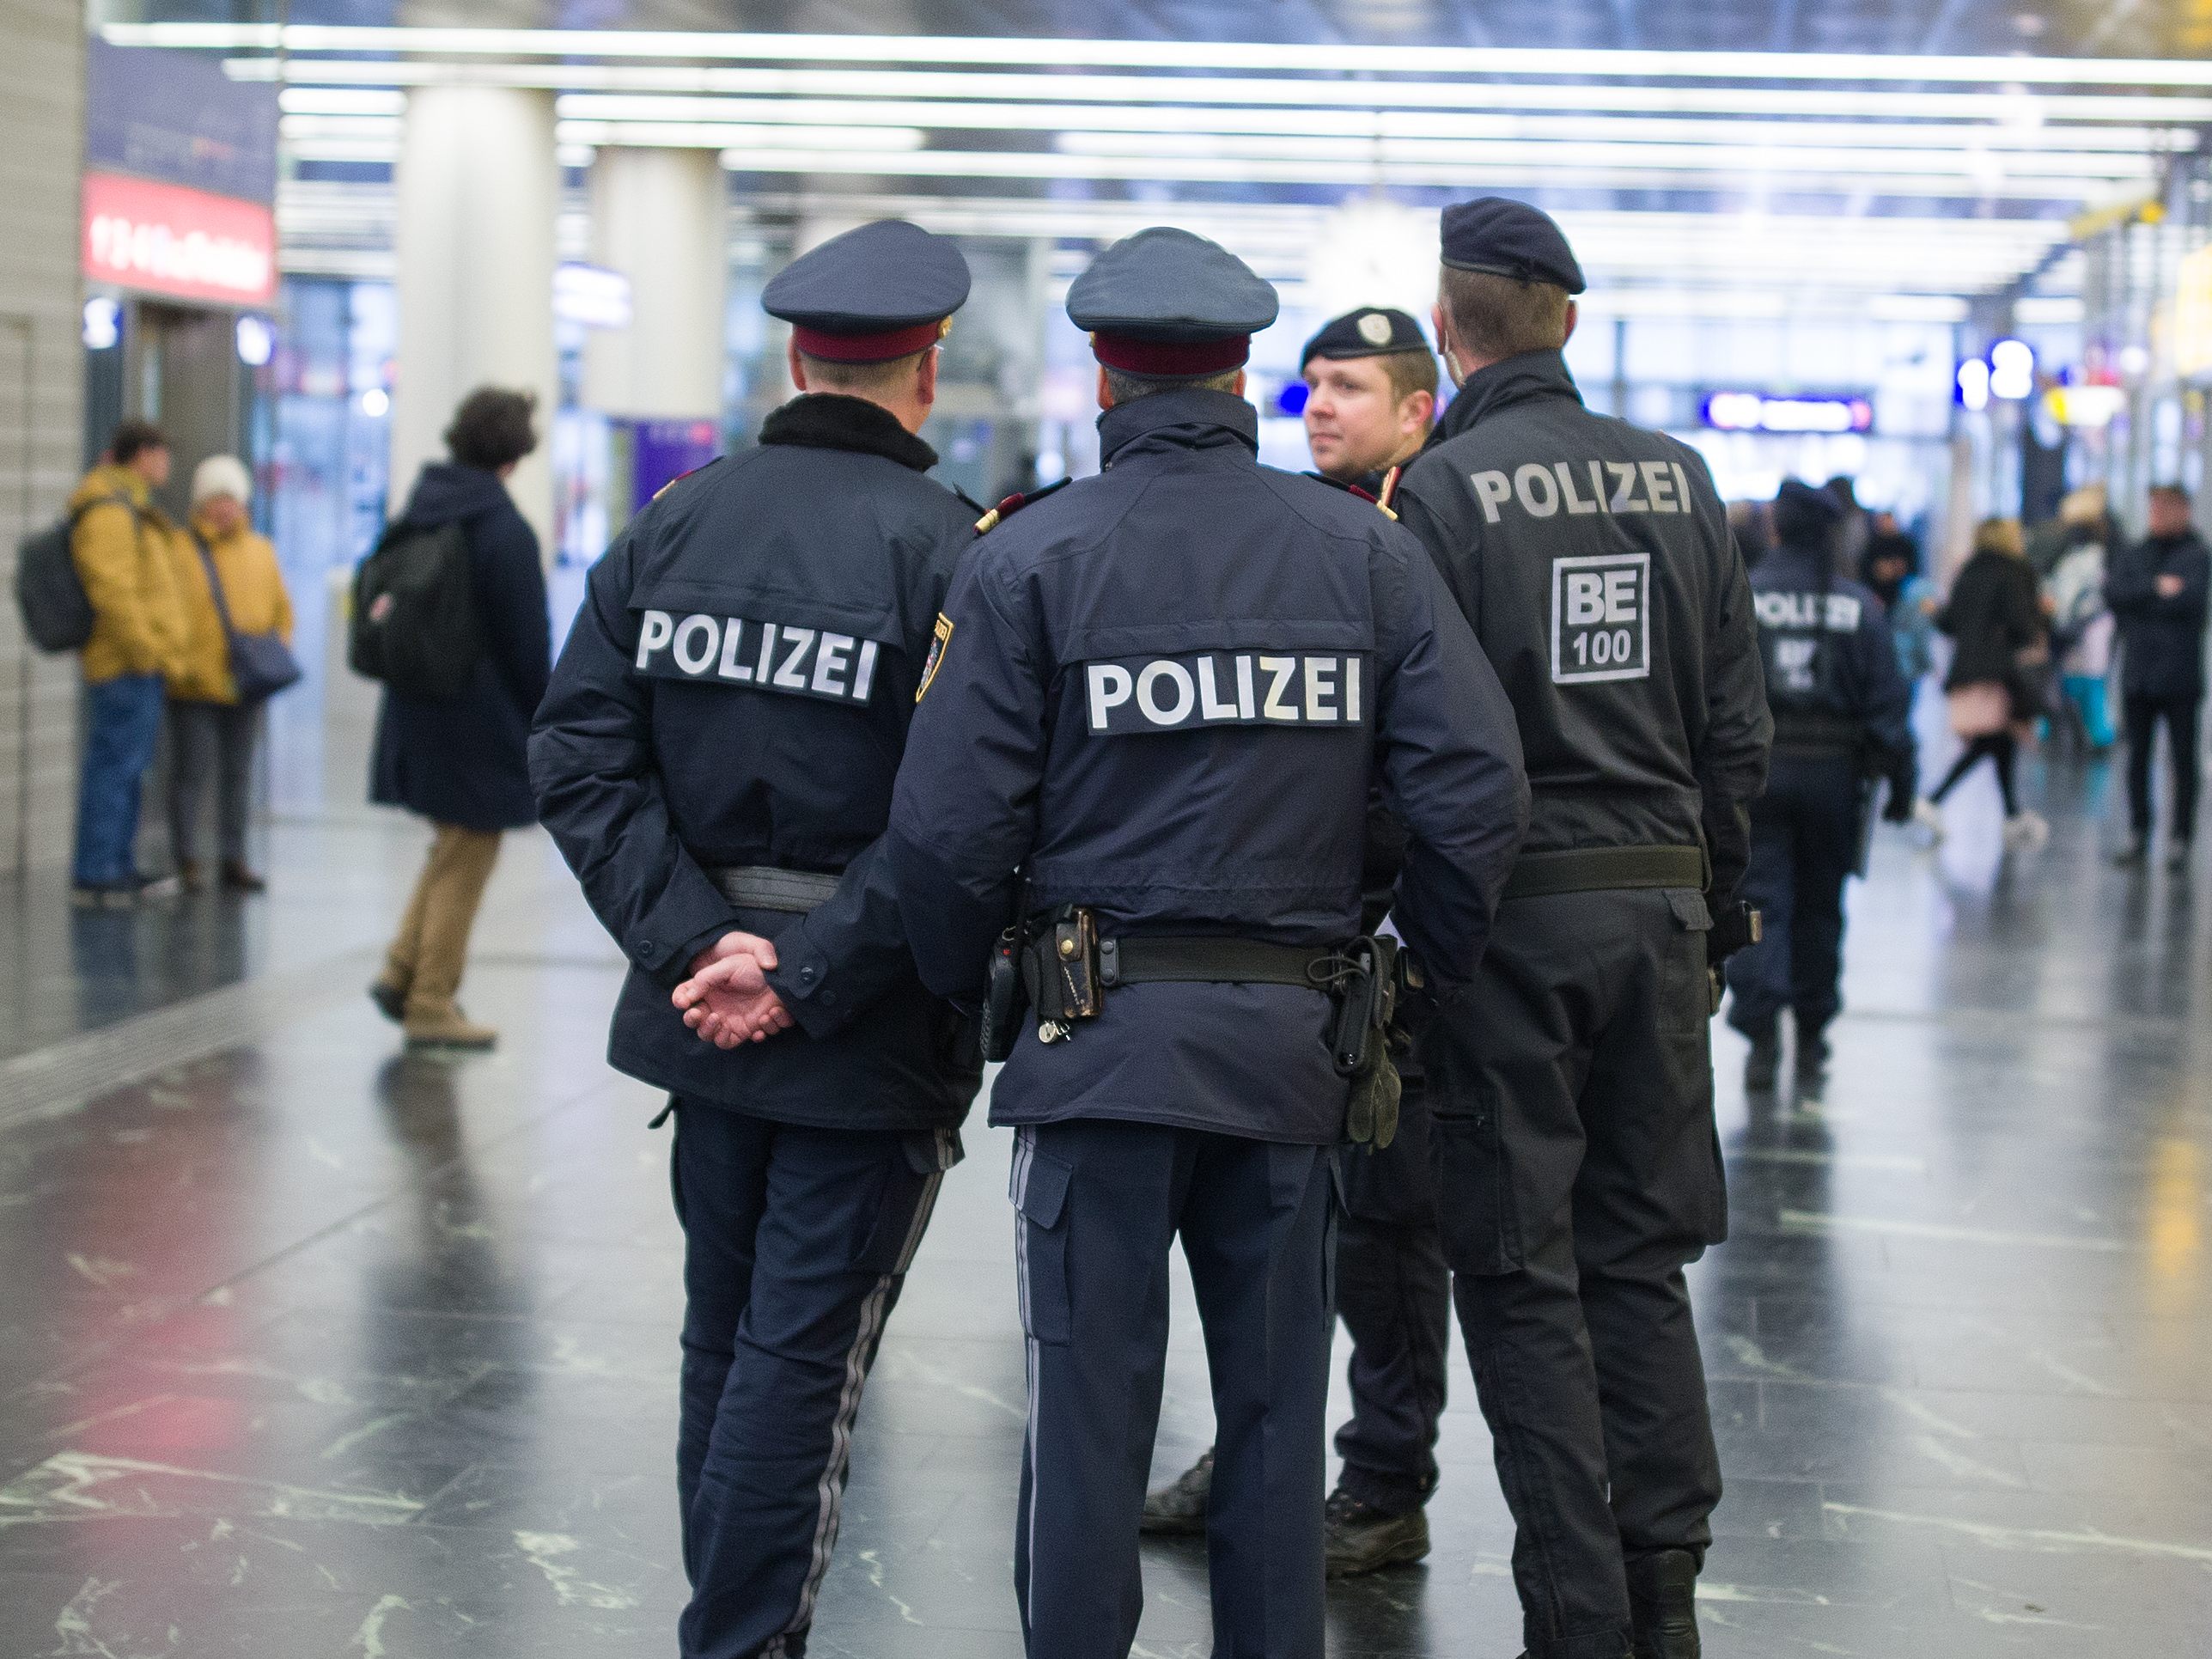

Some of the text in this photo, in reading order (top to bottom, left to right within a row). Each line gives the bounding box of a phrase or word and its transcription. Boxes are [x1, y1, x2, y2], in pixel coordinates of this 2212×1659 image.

[1470, 460, 1691, 524] POLIZEI
[1567, 569, 1637, 626] BE
[636, 609, 877, 700] POLIZEI
[1573, 629, 1631, 666] 100
[1088, 655, 1361, 729] POLIZEI
